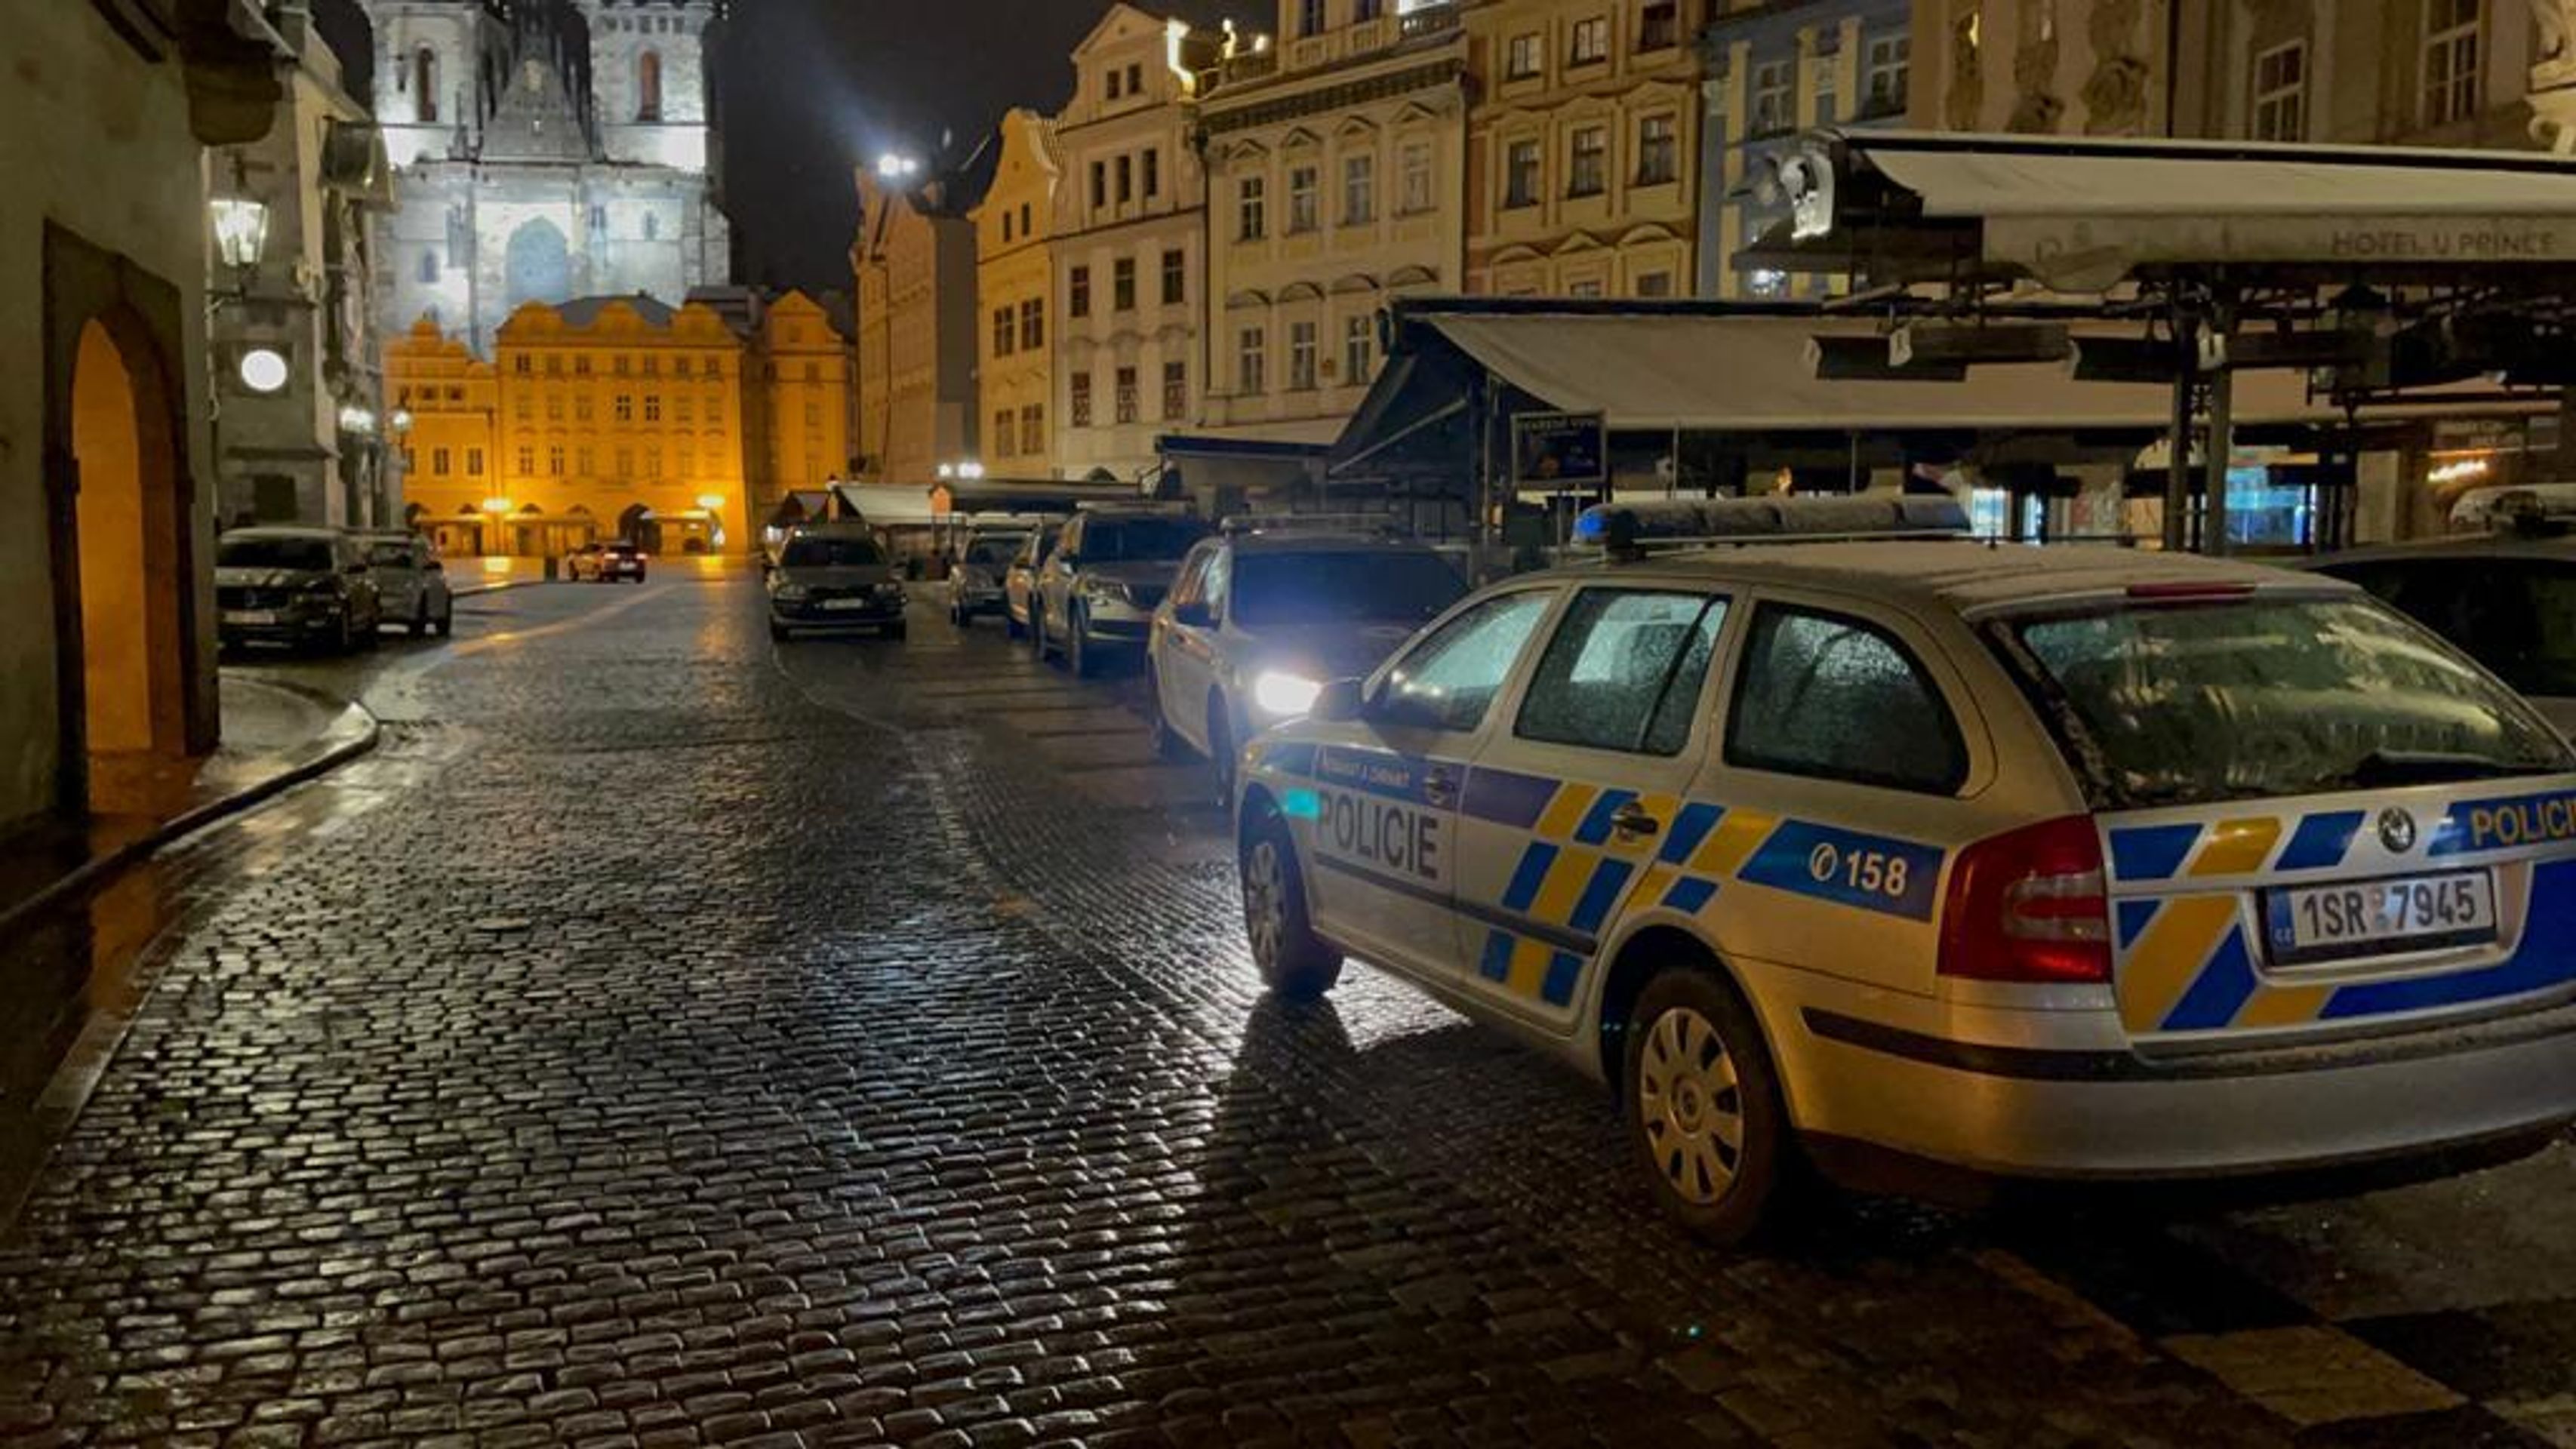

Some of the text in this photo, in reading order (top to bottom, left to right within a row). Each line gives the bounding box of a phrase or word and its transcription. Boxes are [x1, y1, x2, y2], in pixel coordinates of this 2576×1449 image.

[2331, 230, 2424, 256] HOTEL
[2432, 231, 2450, 256] U
[1318, 791, 1438, 879] POLICIE
[2470, 798, 2576, 846] POLICI
[1847, 850, 1908, 897] 158
[2304, 879, 2476, 938] 1SR 7945
